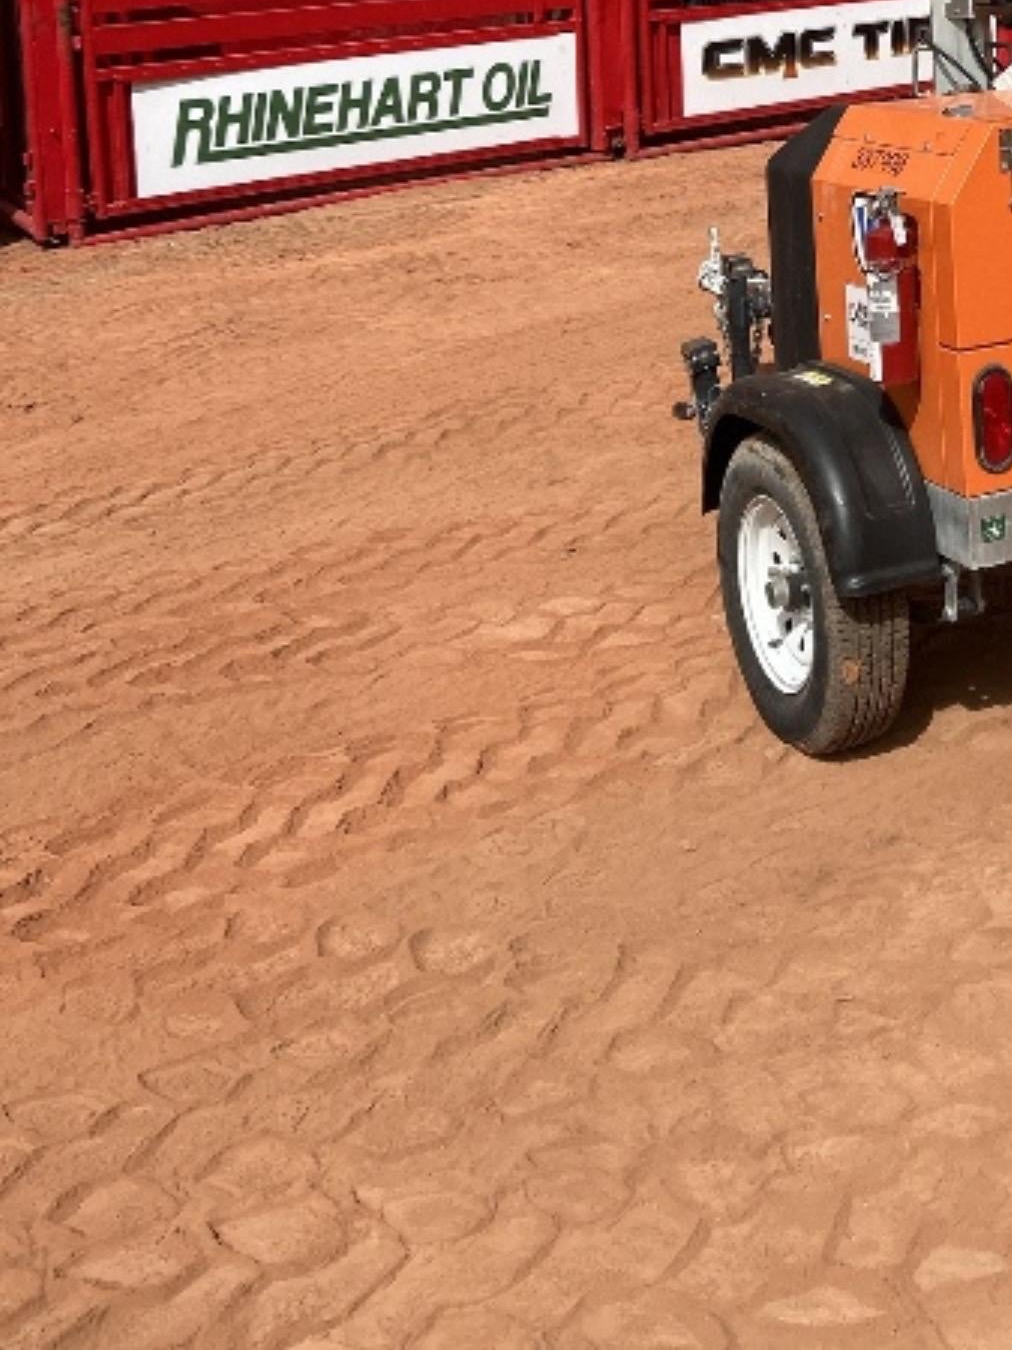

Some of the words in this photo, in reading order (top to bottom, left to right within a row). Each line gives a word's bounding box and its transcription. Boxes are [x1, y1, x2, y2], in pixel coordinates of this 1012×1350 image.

[701, 26, 836, 80] CMC
[171, 66, 474, 168] RHINEHART
[482, 59, 553, 112] OIL
